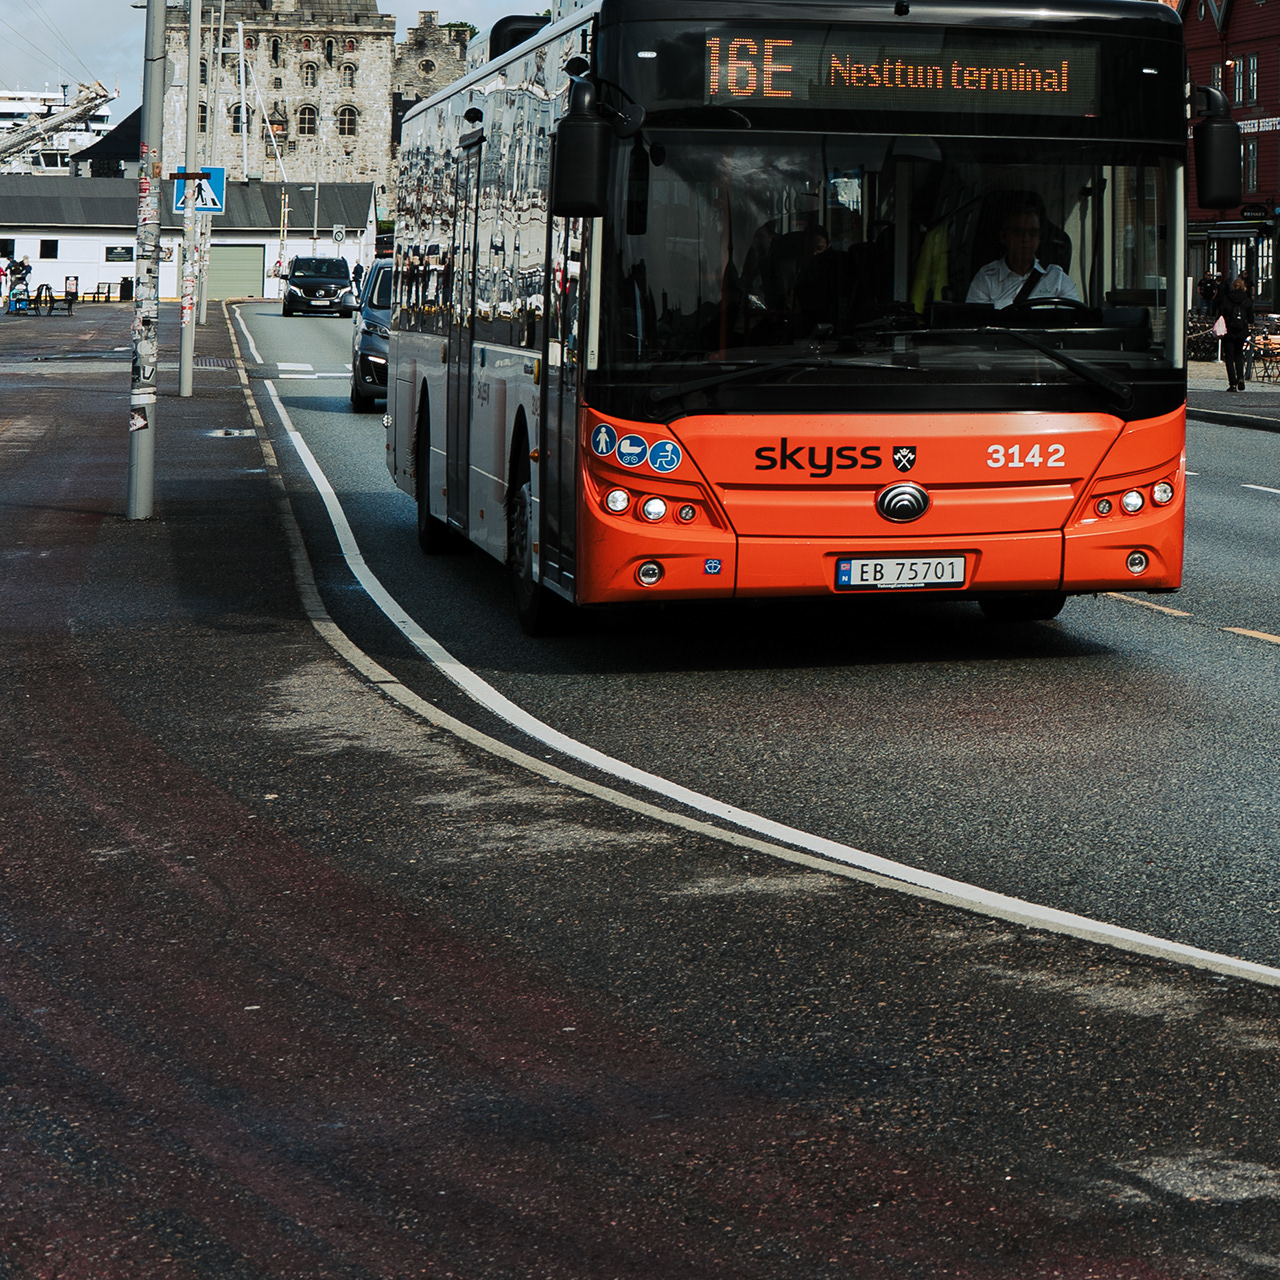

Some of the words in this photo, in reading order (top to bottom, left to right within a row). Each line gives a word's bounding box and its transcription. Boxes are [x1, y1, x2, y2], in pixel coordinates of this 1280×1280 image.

[706, 37, 793, 98] 16E
[830, 53, 943, 89] Nesttun
[951, 60, 1068, 92] terminal
[754, 437, 882, 478] skyss
[986, 444, 1066, 467] 3142
[860, 562, 884, 583] EB
[895, 560, 956, 581] 75701
